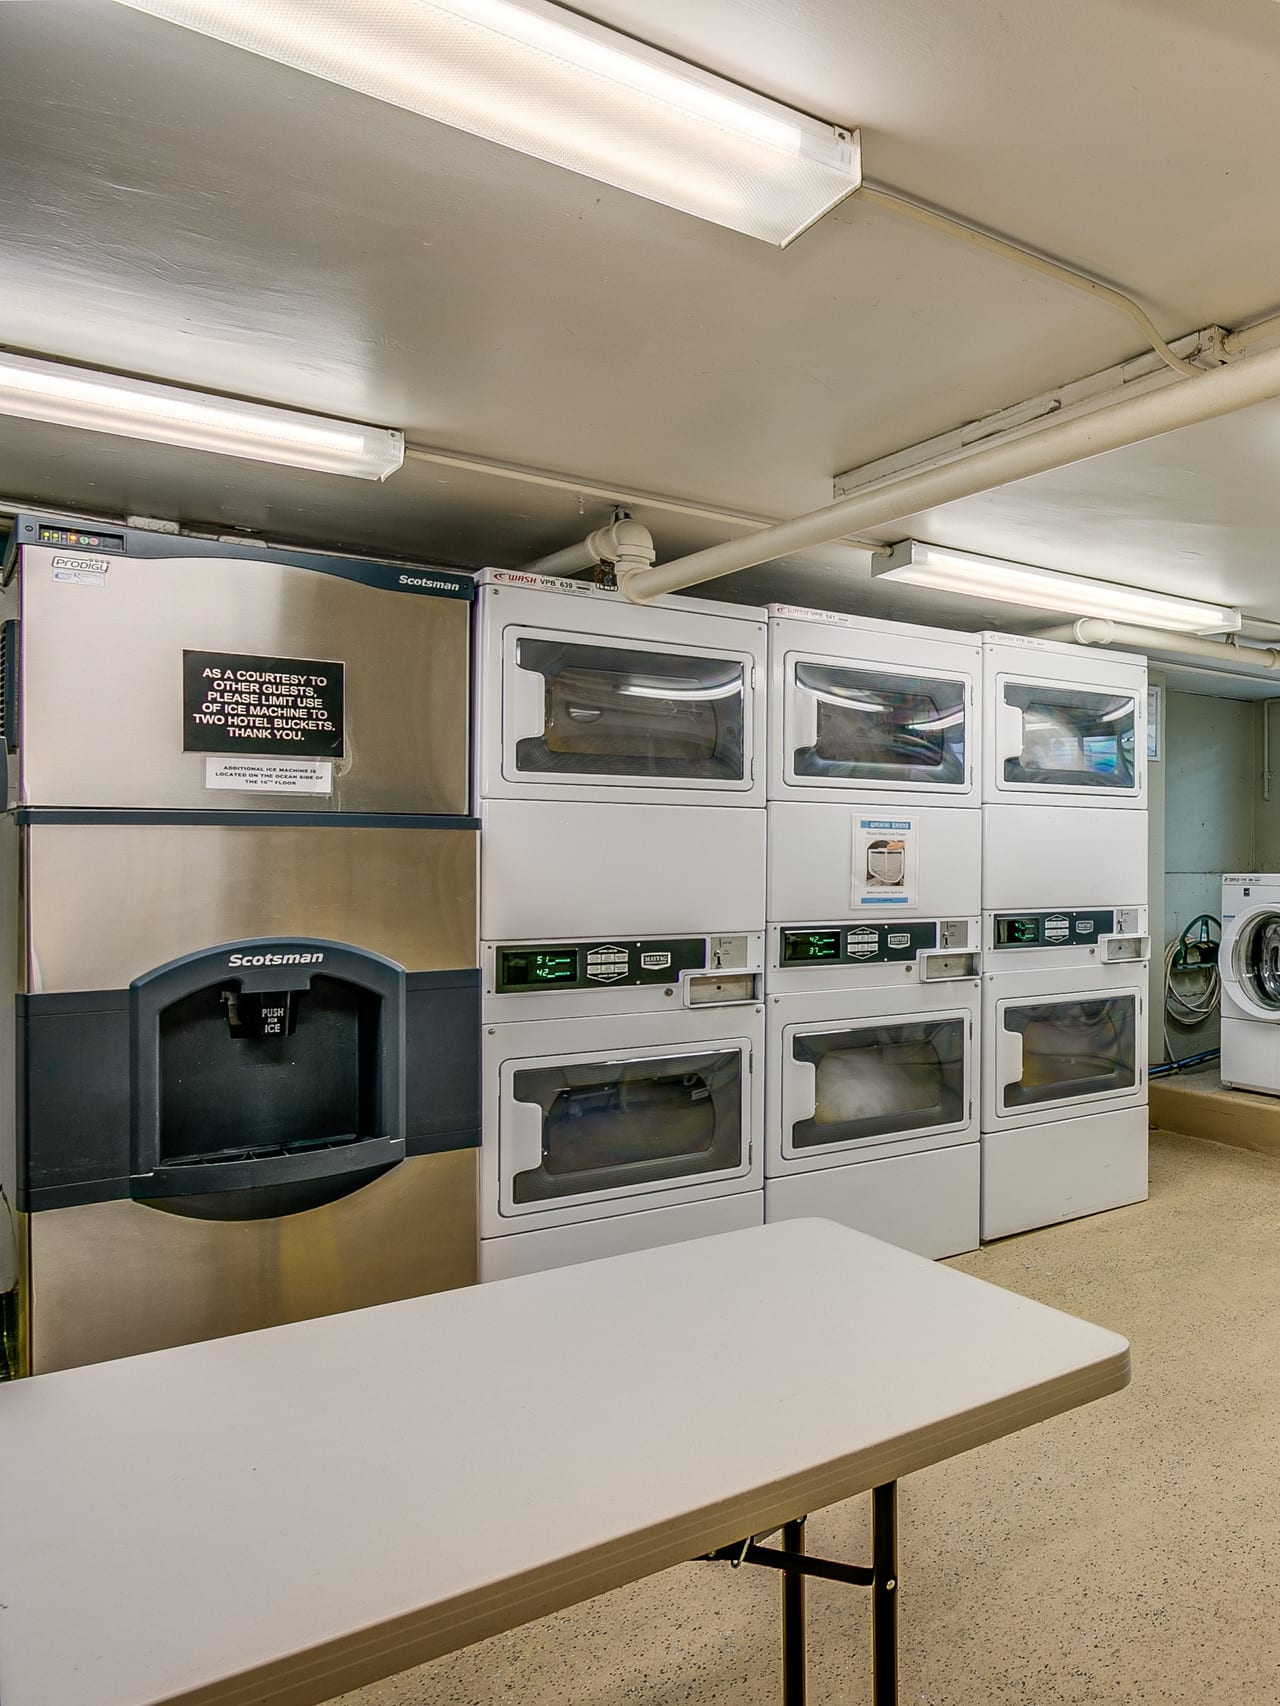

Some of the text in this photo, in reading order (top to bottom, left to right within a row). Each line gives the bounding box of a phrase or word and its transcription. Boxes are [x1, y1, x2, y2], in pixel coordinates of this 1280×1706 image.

[398, 575, 460, 591] Scotsman
[508, 574, 537, 584] WASH
[540, 578, 556, 587] VPB
[202, 668, 327, 687] AS A COURTESY TO
[213, 681, 260, 693] OTHER
[207, 691, 323, 708] PLEASE LIMIT USE
[202, 703, 328, 720] OF ICE MACHINE TO
[193, 713, 336, 731] TWO HOTEL BUCKETS.
[227, 727, 305, 741] THANK YOU.
[228, 952, 324, 967] Scotsman
[261, 1008, 284, 1018] PUSH
[264, 1023, 281, 1033] ICE
